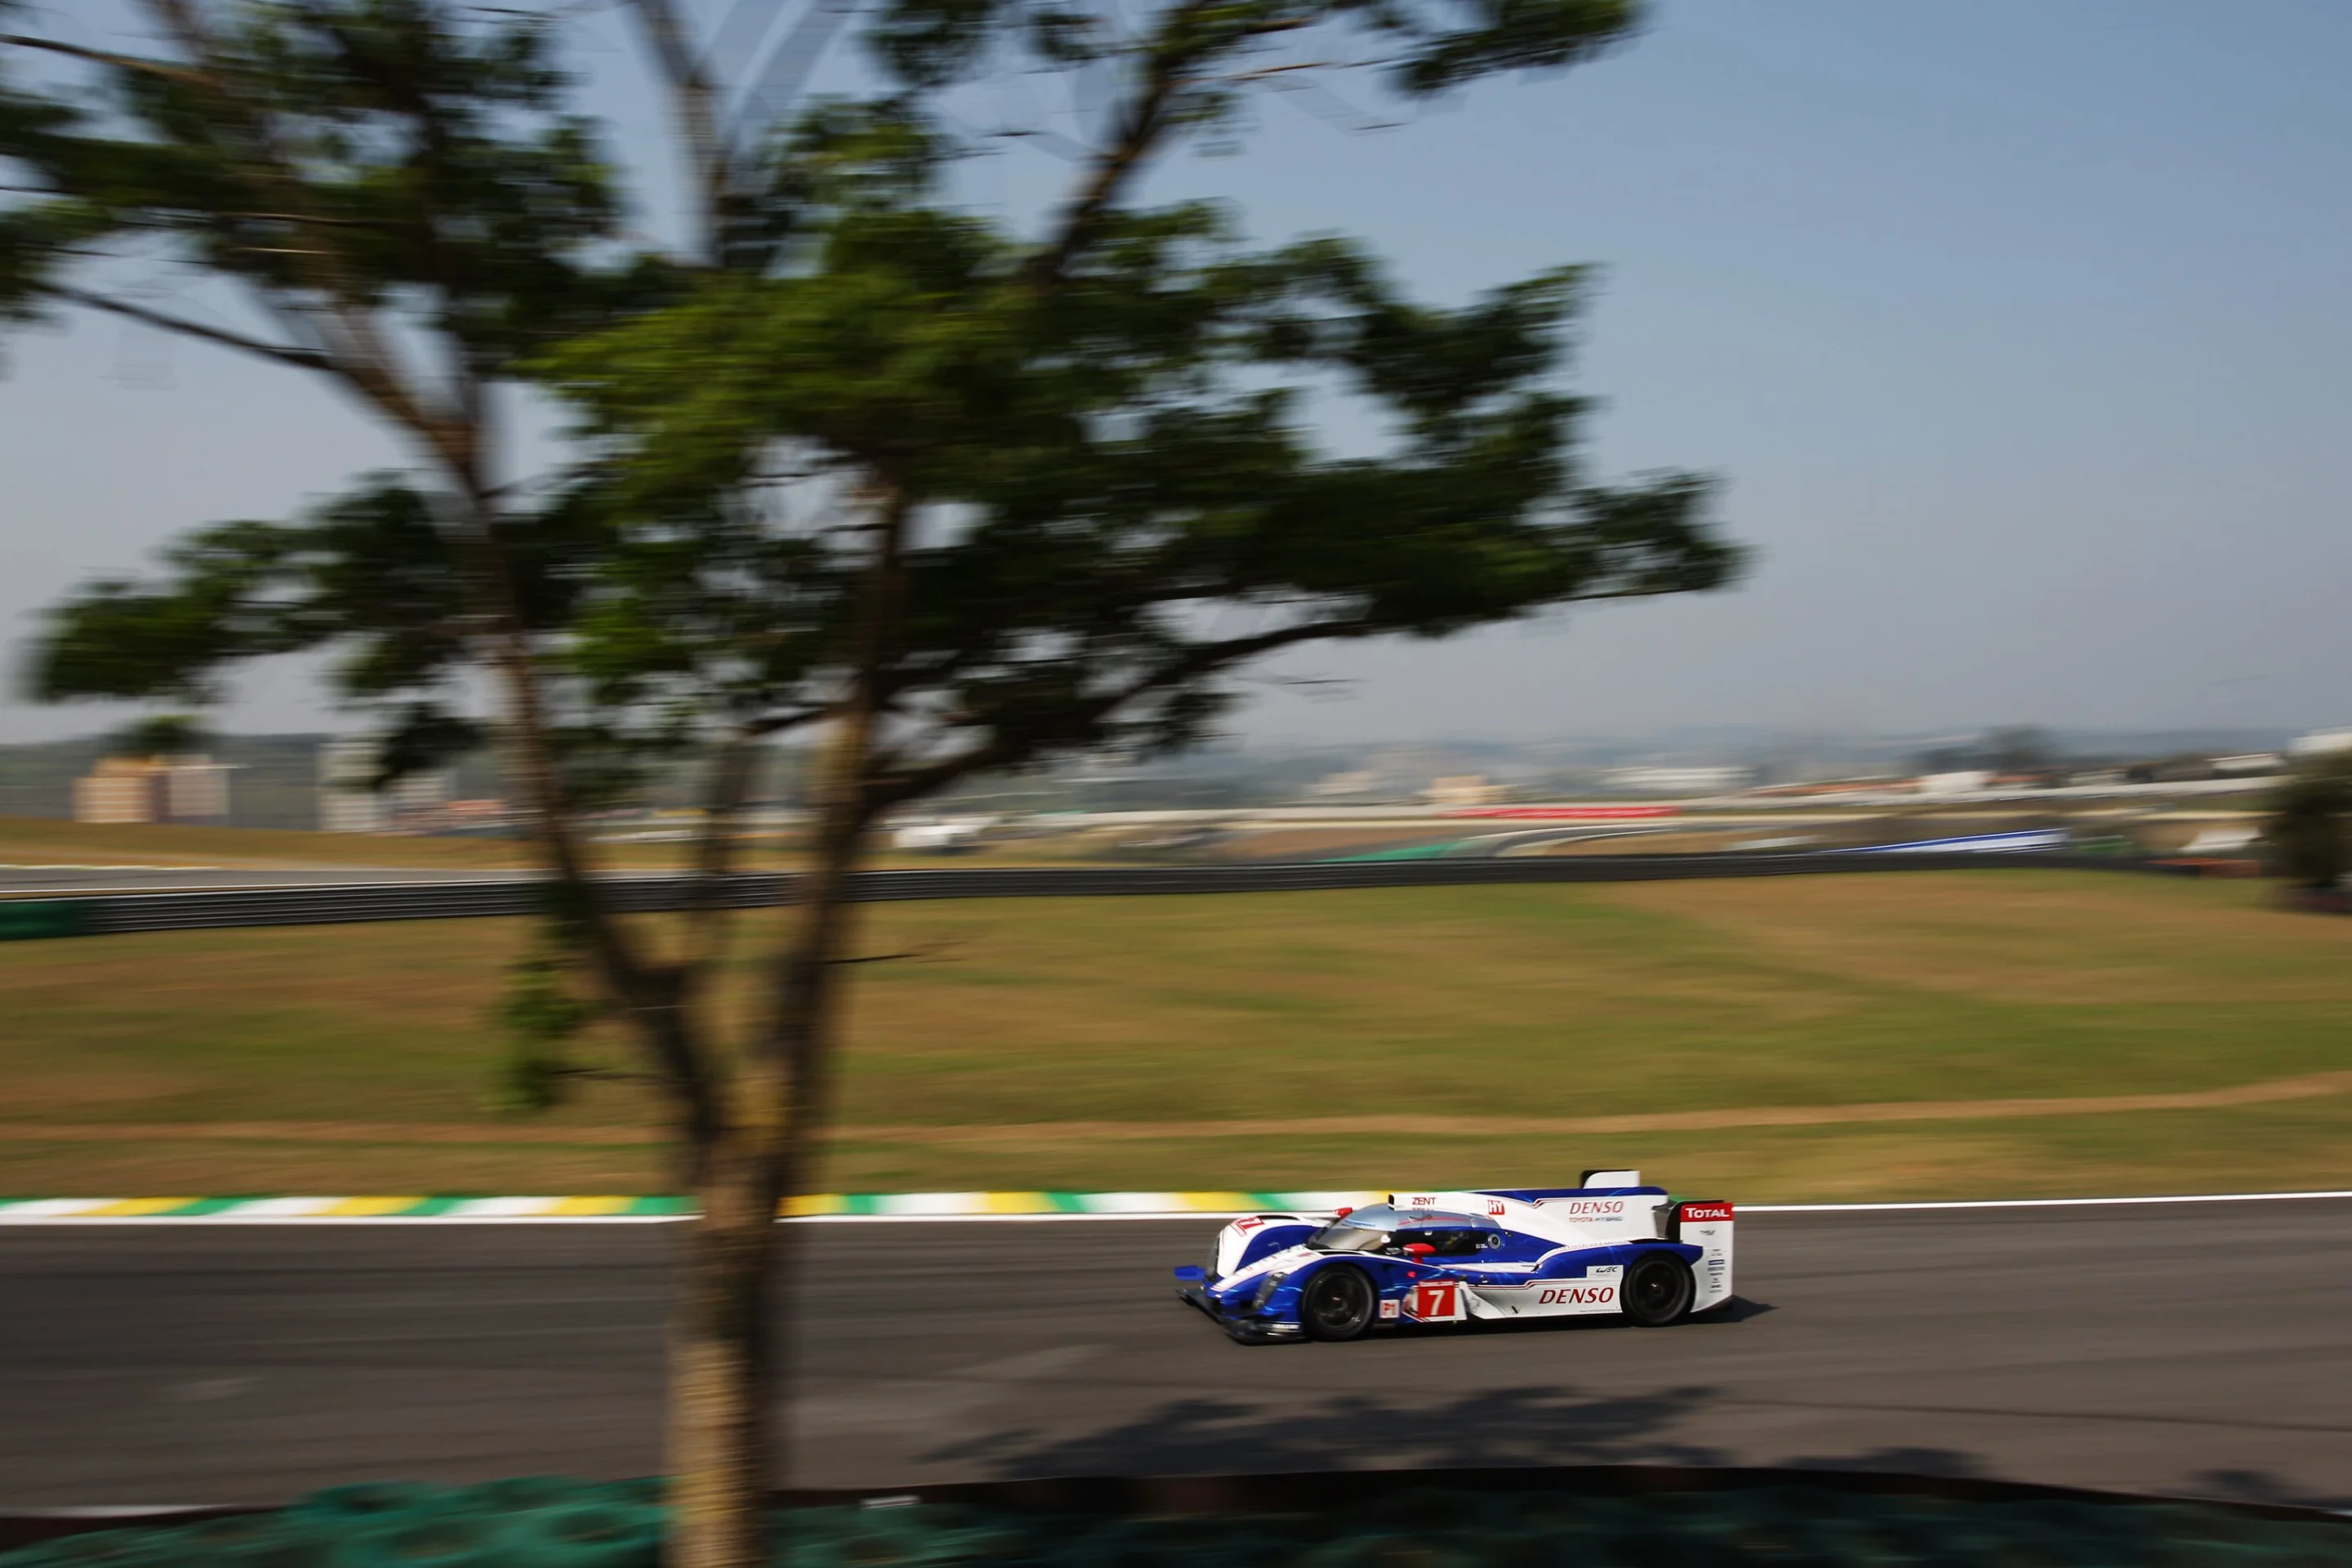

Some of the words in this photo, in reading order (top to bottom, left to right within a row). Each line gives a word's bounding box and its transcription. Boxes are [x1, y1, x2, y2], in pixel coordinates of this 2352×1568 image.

[1412, 1197, 1437, 1205] ZENT
[1489, 1200, 1503, 1213] HY
[1570, 1200, 1624, 1214] DENSO
[1686, 1209, 1730, 1218] TOTAL
[1539, 1287, 1615, 1304] DENSO
[1428, 1290, 1445, 1316] 7
